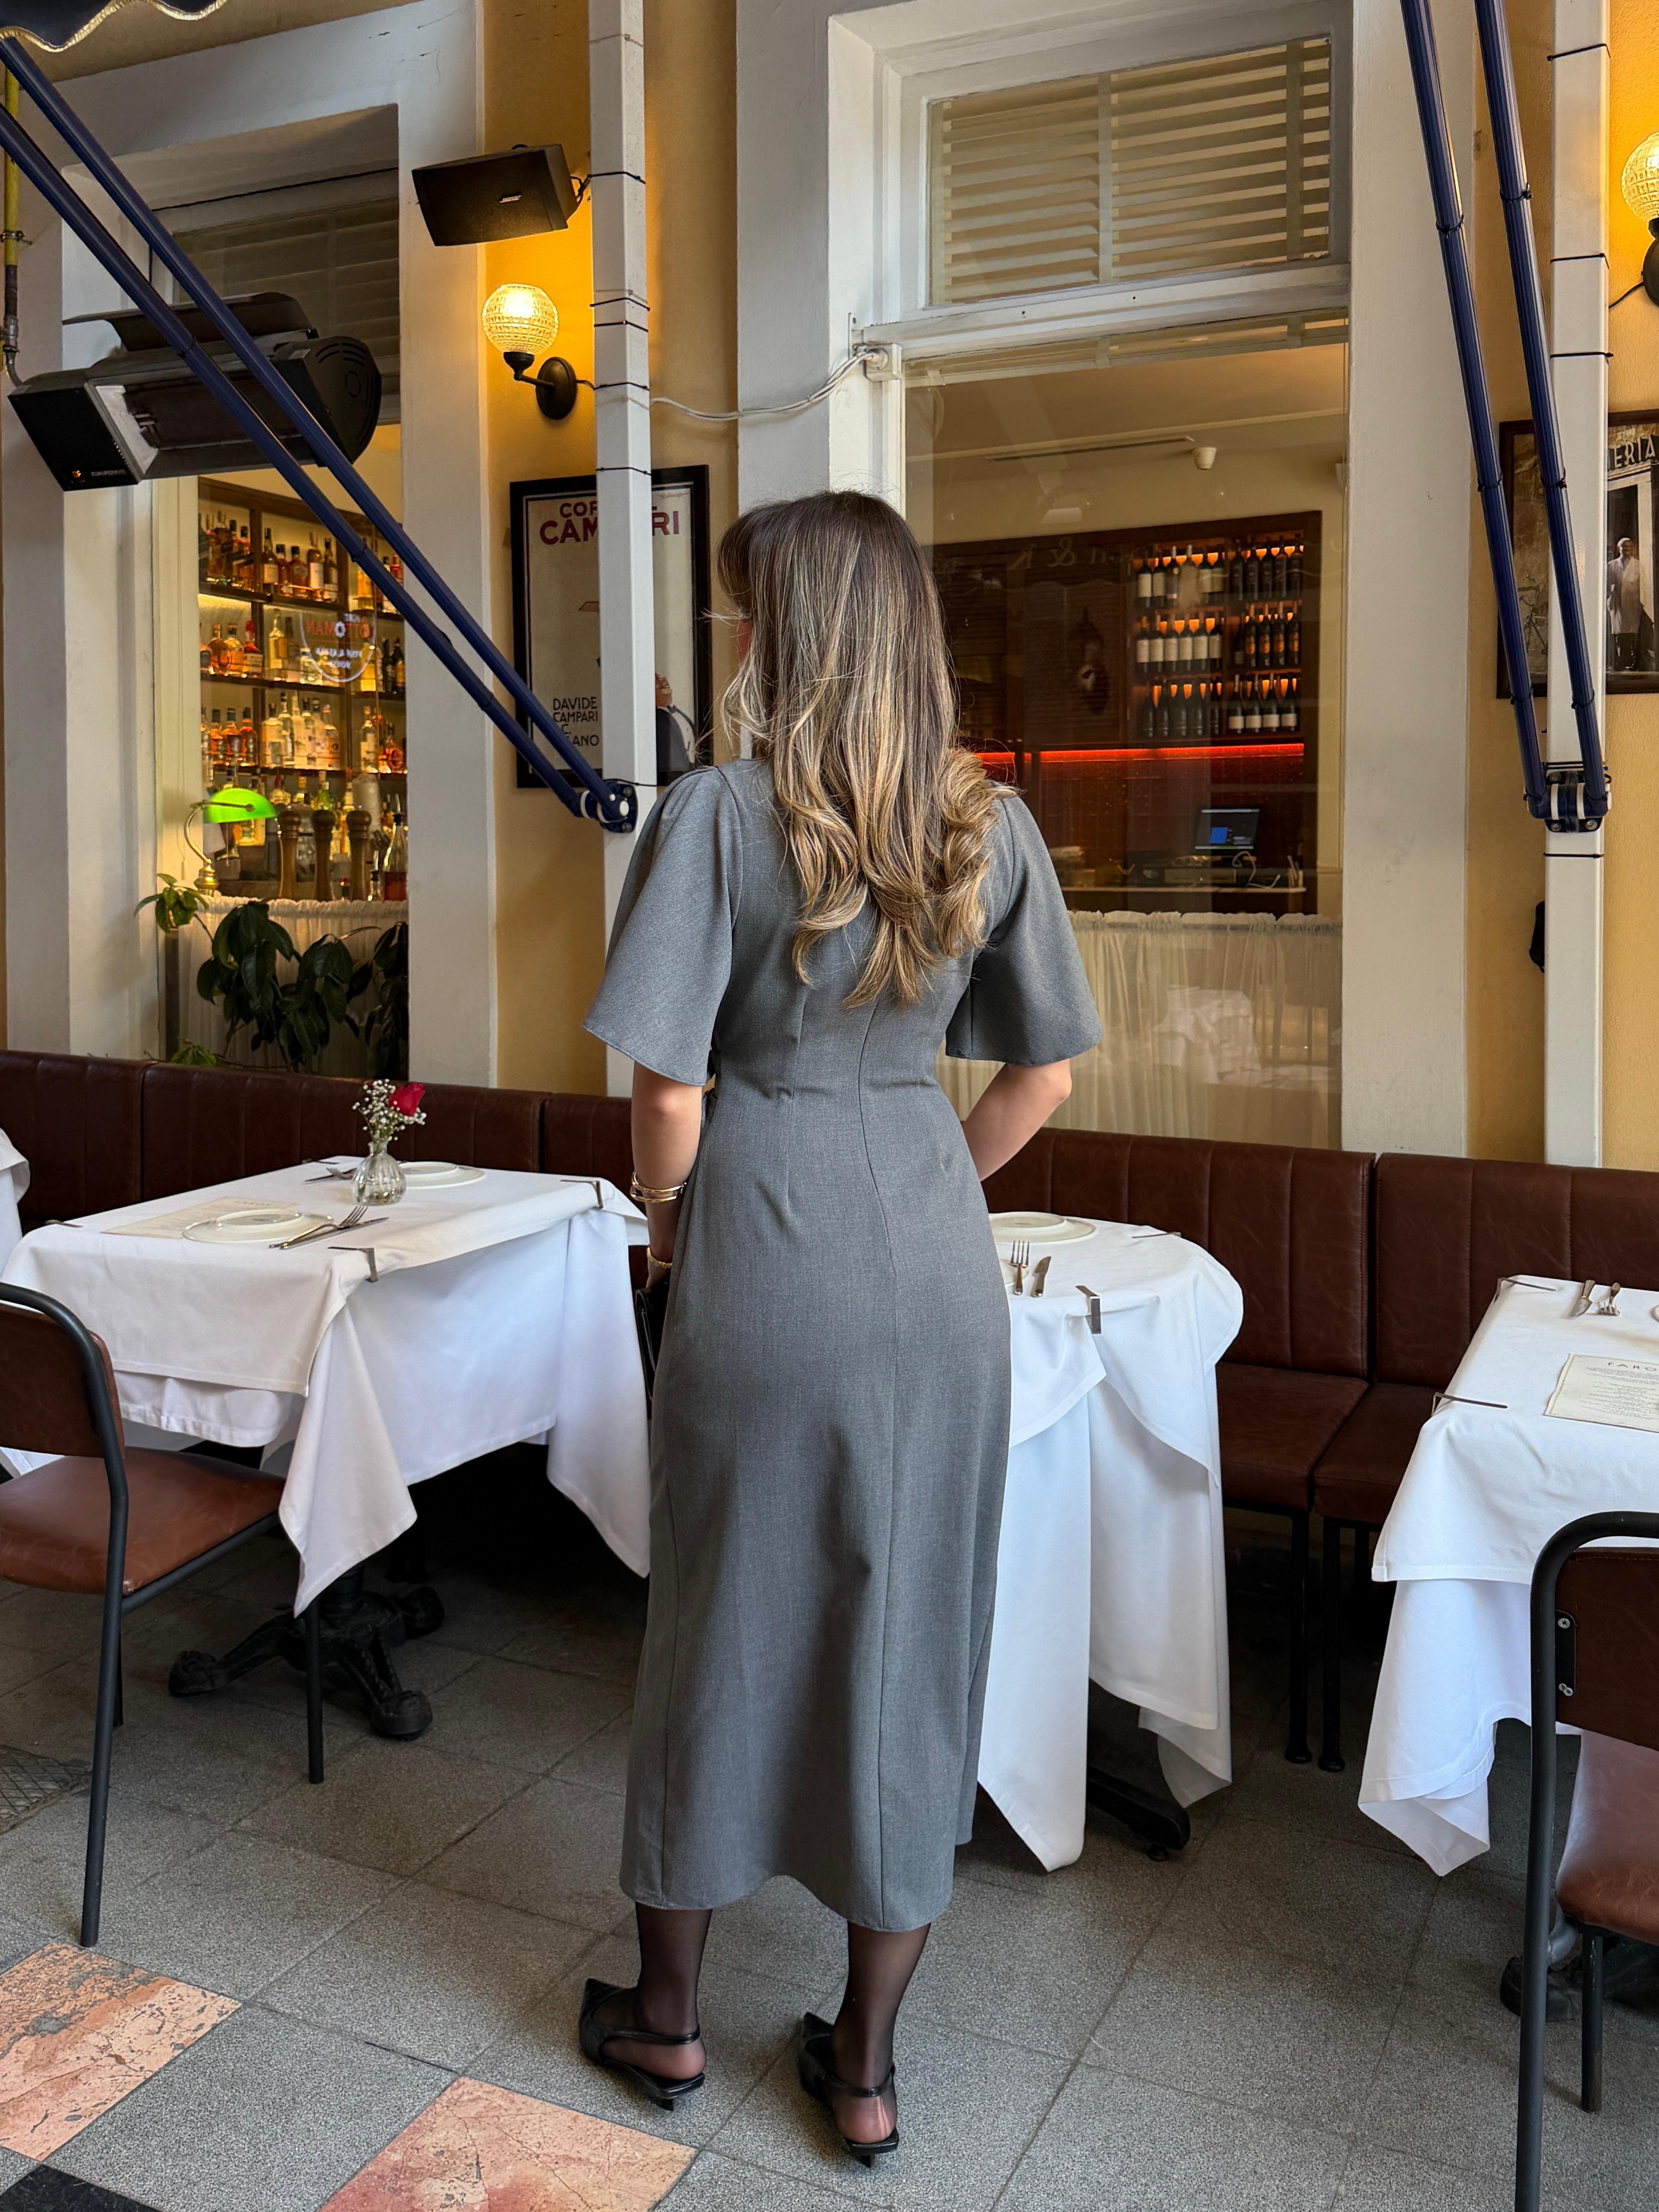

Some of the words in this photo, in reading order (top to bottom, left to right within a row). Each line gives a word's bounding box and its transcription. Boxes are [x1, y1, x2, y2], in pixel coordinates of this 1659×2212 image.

[540, 511, 679, 545] CAMRI
[553, 696, 598, 711] DAVIDE
[553, 711, 598, 723] CAMPARI
